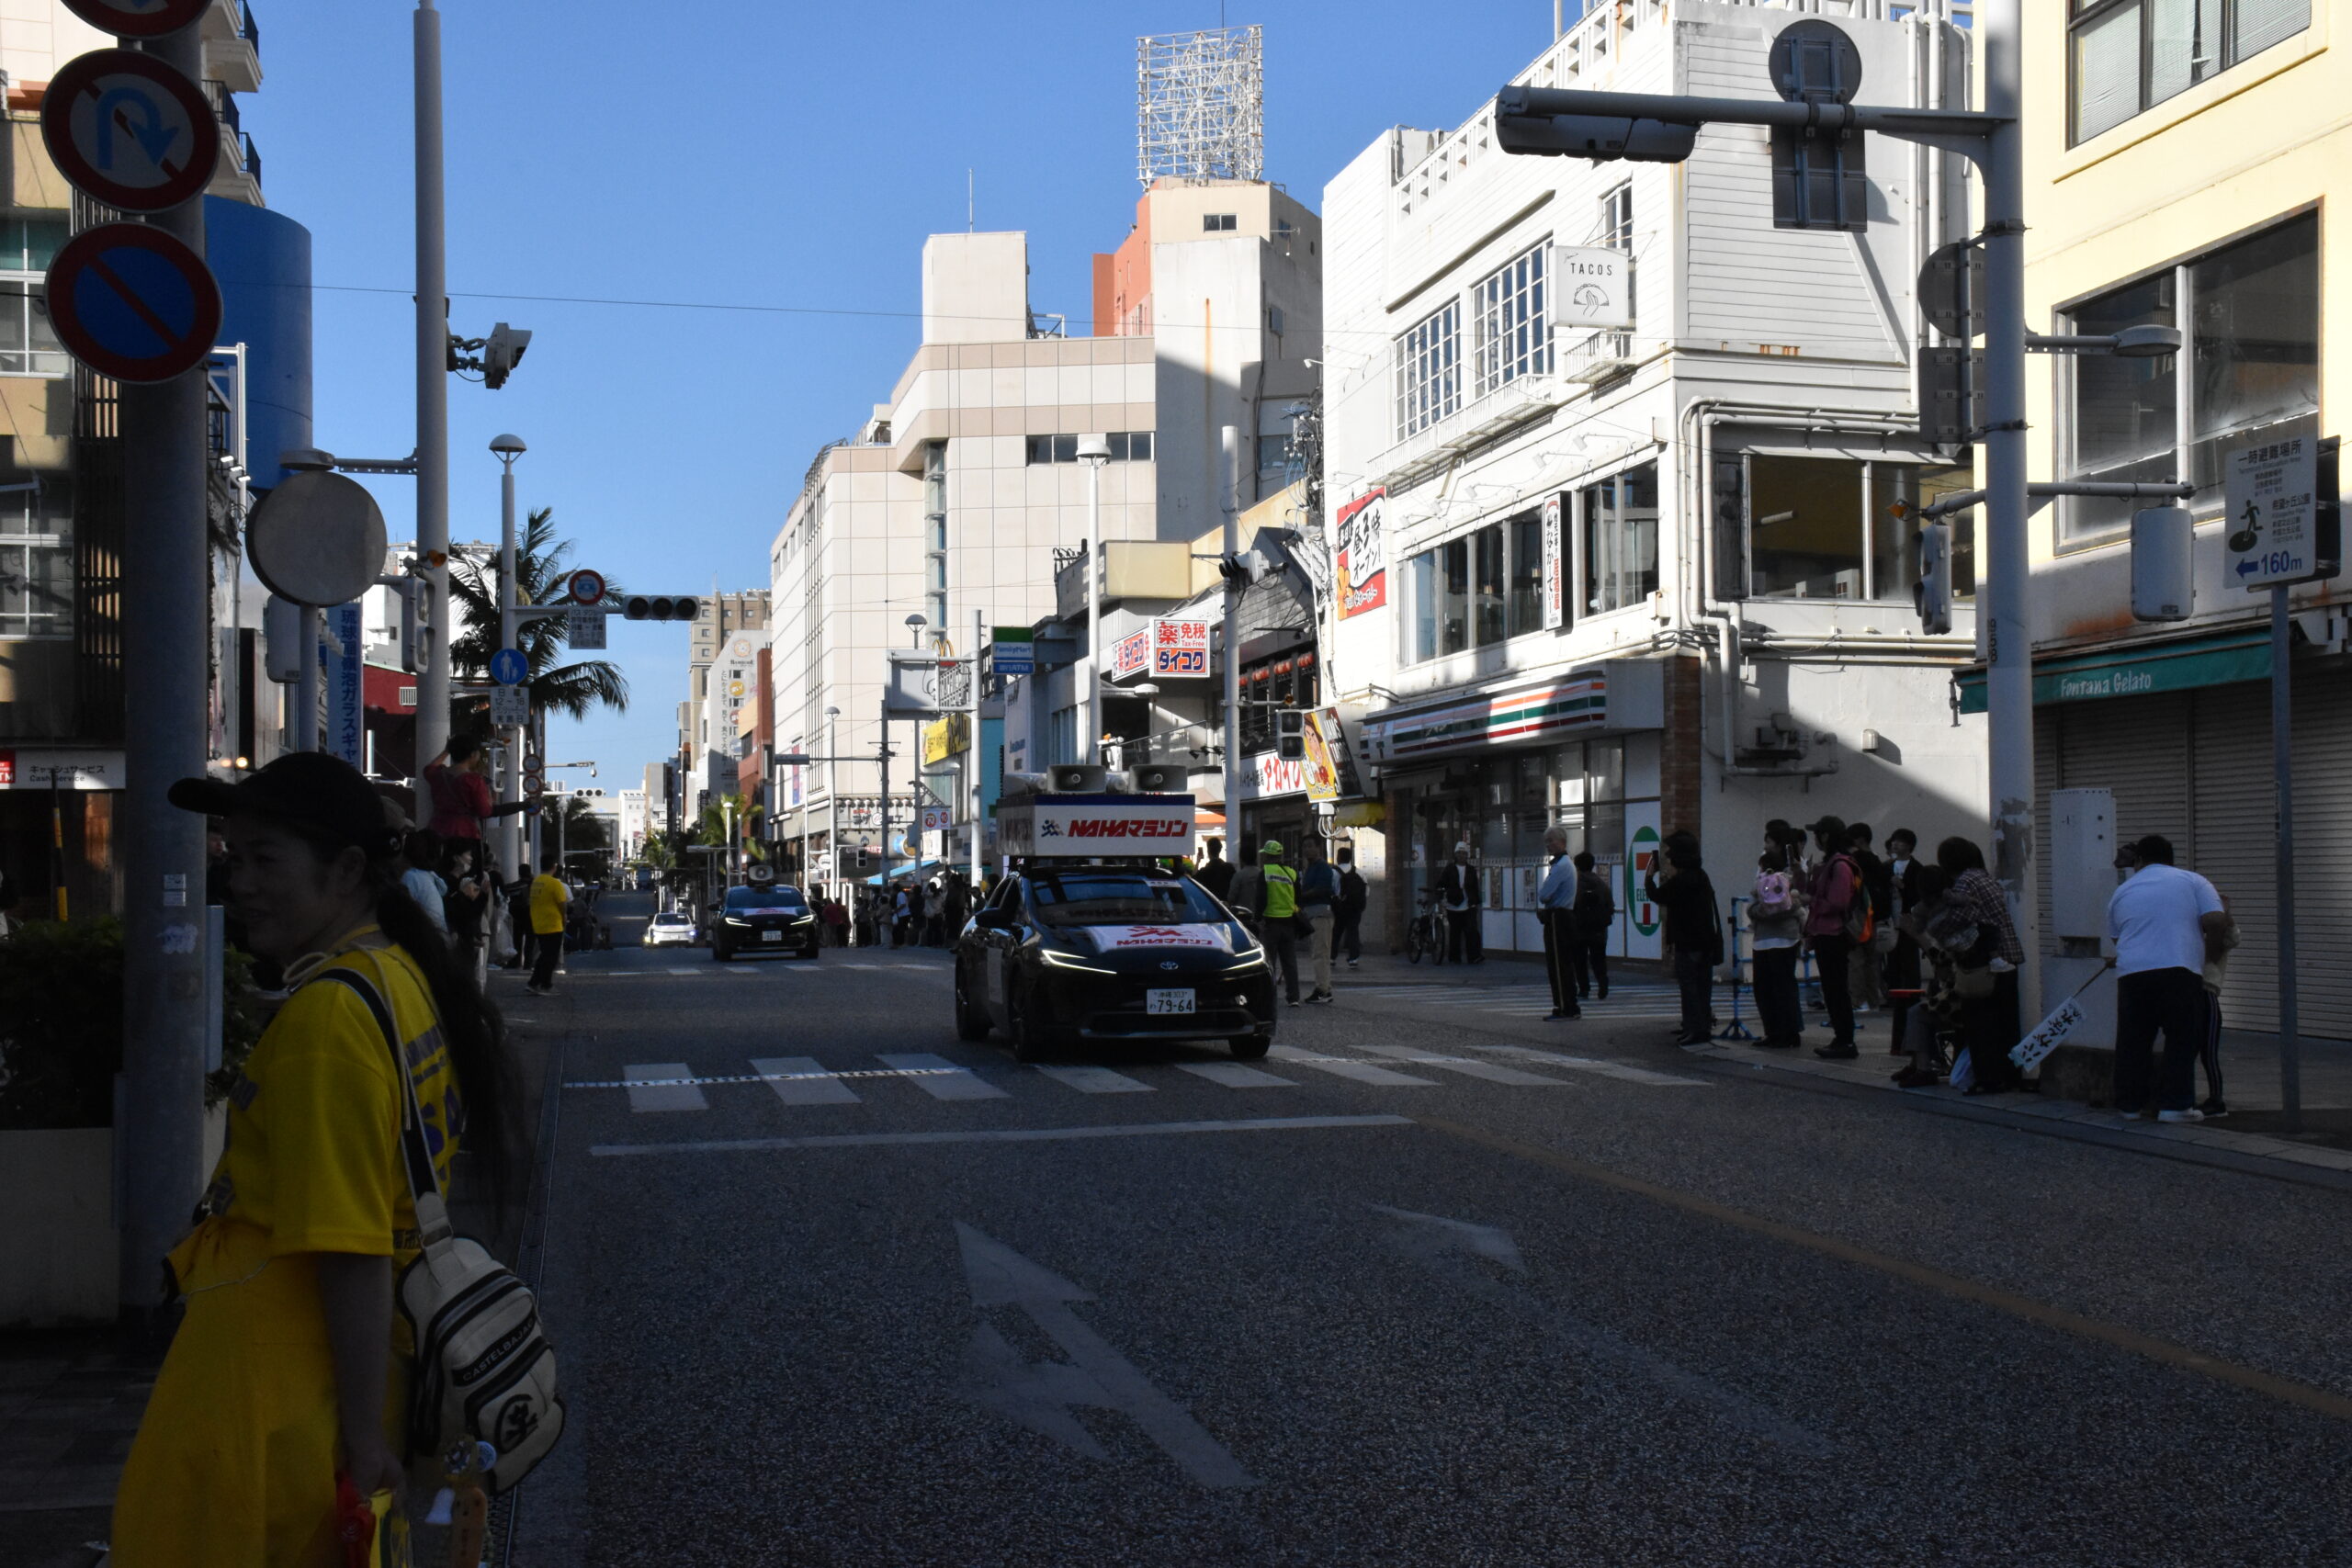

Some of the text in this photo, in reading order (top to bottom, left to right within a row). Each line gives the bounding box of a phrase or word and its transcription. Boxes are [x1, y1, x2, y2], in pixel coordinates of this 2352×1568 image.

[1570, 263, 1612, 276] TACOS
[2260, 550, 2302, 576] 160m
[1158, 621, 1206, 646] 薬 免税
[995, 645, 1033, 655] FamilyMart
[1159, 649, 1204, 671] ダイコク
[2114, 670, 2152, 693] Gelato
[1068, 819, 1188, 838] NAHAマラソン
[1158, 999, 1193, 1013] 79-64
